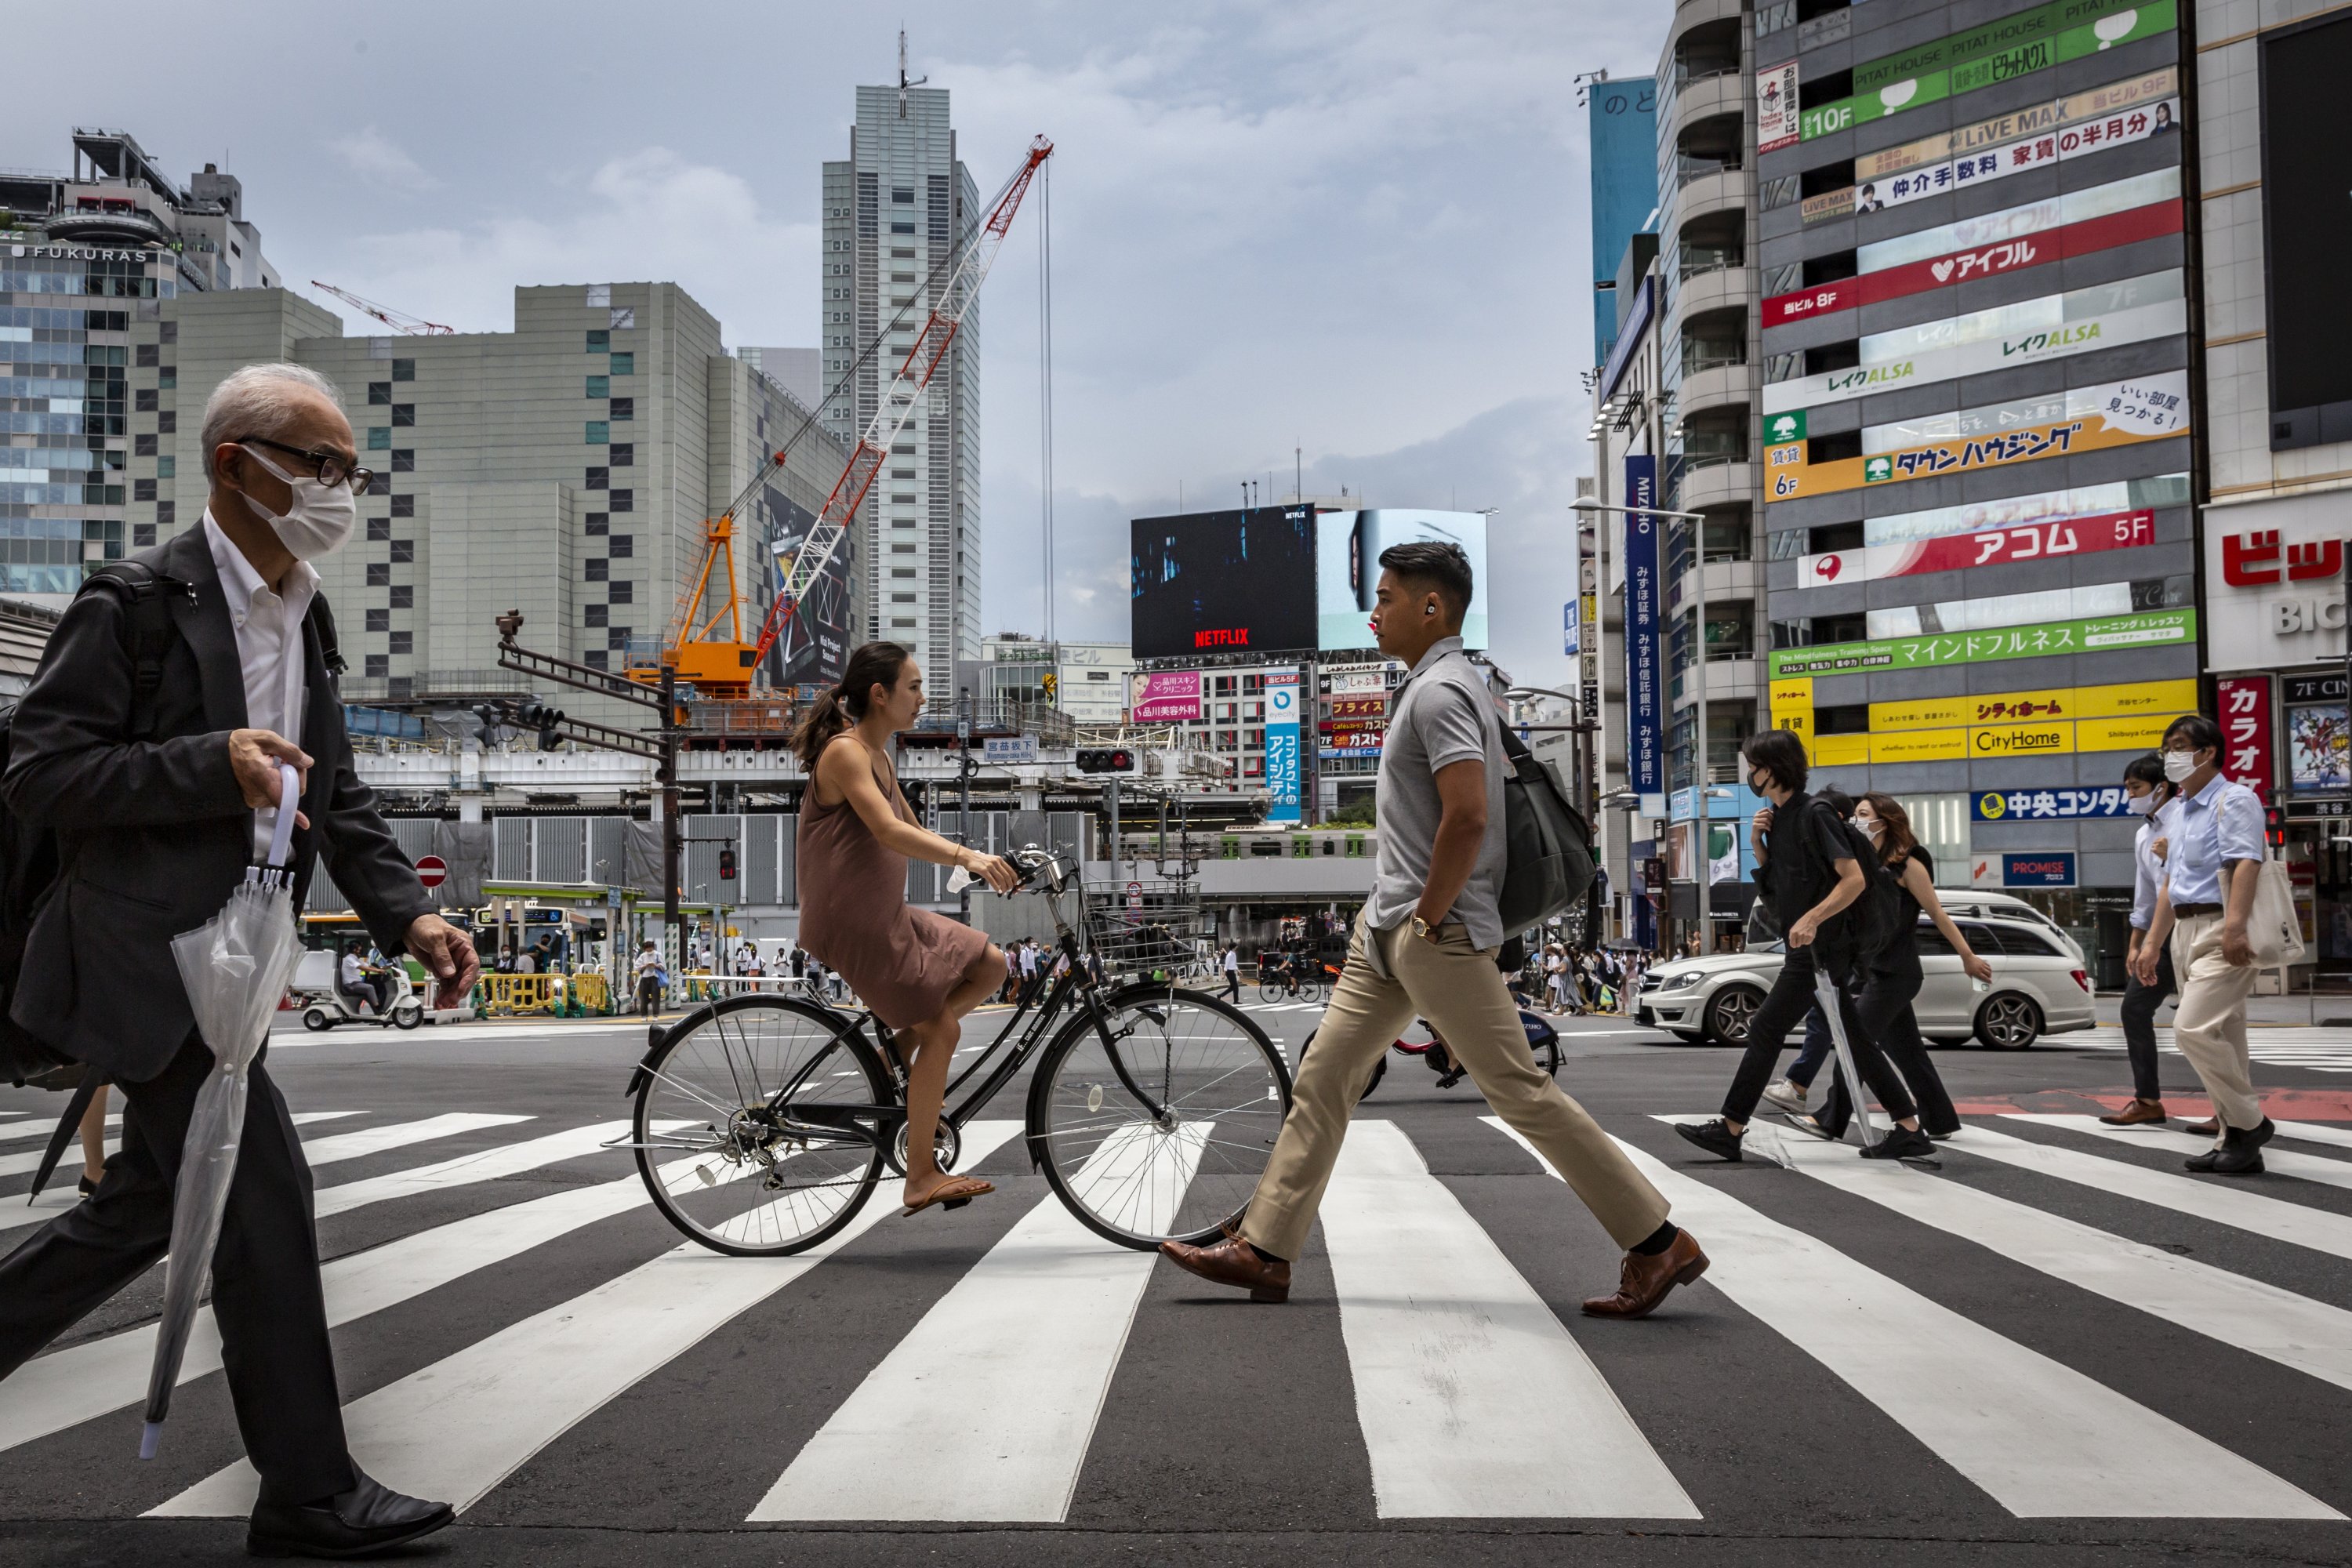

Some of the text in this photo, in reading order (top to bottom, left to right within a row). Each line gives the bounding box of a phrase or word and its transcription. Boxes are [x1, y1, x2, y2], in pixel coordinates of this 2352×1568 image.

[1952, 16, 2046, 56] PITAT HOUSE
[1855, 49, 1943, 86] PITAT HOUSE
[1784, 67, 1796, 134] お部屋探しは
[2093, 76, 2166, 109] 当ビル 9F
[1605, 89, 1655, 115] のど
[1813, 107, 1851, 135] 10F
[2018, 102, 2069, 132] MAX
[1893, 112, 2148, 198] 仲介手数料 家賃の半月分
[1829, 191, 1853, 207] MAX
[34, 247, 147, 263] FUKURAS
[1956, 240, 2036, 278] アイフル
[1784, 292, 1837, 315] 当ビル 8F
[2003, 322, 2102, 357] レイクALSA
[1828, 361, 1914, 391] レイクALSA
[2121, 384, 2180, 411] いい部屋
[2106, 397, 2177, 430] 見つかる！
[1772, 447, 1799, 465] 賃貸
[1775, 474, 1798, 495] 6F
[1285, 511, 1305, 520] NETFLIX
[1974, 523, 2078, 564] アコム
[2114, 516, 2149, 541] 5F
[1637, 566, 1650, 625] みずほ証券
[2085, 617, 2136, 633] トレーニング
[2148, 616, 2184, 627] レッスン
[1195, 628, 1249, 648] NETFLIX
[1901, 628, 2075, 662] マインドフルネス
[1794, 650, 1837, 662] Mindfulness
[1839, 647, 1869, 658] Training
[1870, 644, 1893, 655] Space
[1327, 663, 1382, 673] しゃぶしゃぶバイキング
[1638, 633, 1652, 717] みずほ信託銀行
[1781, 664, 1804, 673] ストレス
[1162, 677, 1196, 686] 品川スキン
[1268, 675, 1296, 684] 当ビル5F
[1320, 680, 1330, 688] 9F
[1350, 675, 1381, 687] しゃぶ葉
[2219, 681, 2234, 691] 6F
[1162, 684, 1193, 694] クリニック
[1777, 691, 1806, 699] シティホーム
[2296, 682, 2316, 696] 7F
[1977, 699, 2062, 720] シティホーム
[2118, 697, 2158, 706] 渋谷センター
[1142, 704, 1196, 717] 品川美容外科
[1269, 710, 1296, 719] eyecity
[1882, 711, 1958, 723] しあわせ探し 部屋さがし
[1365, 720, 1389, 730] ガスト
[1780, 717, 1803, 730] 賃貸
[1320, 736, 1332, 745] 7F
[1349, 733, 1381, 746] ガスト
[1976, 731, 2060, 750] CityHome
[2107, 729, 2139, 739] Shibuya
[988, 740, 1033, 752] 宮益坂下
[1341, 748, 1382, 757] 英会話イーオ
[1882, 743, 1907, 752] whether
[1639, 725, 1653, 785] みずほ銀行
[1269, 736, 1284, 804] アイシティ
[1286, 735, 1297, 804] コンタクトの
[2316, 803, 2343, 815] 渋谷
[2013, 862, 2064, 874] PROMISE
